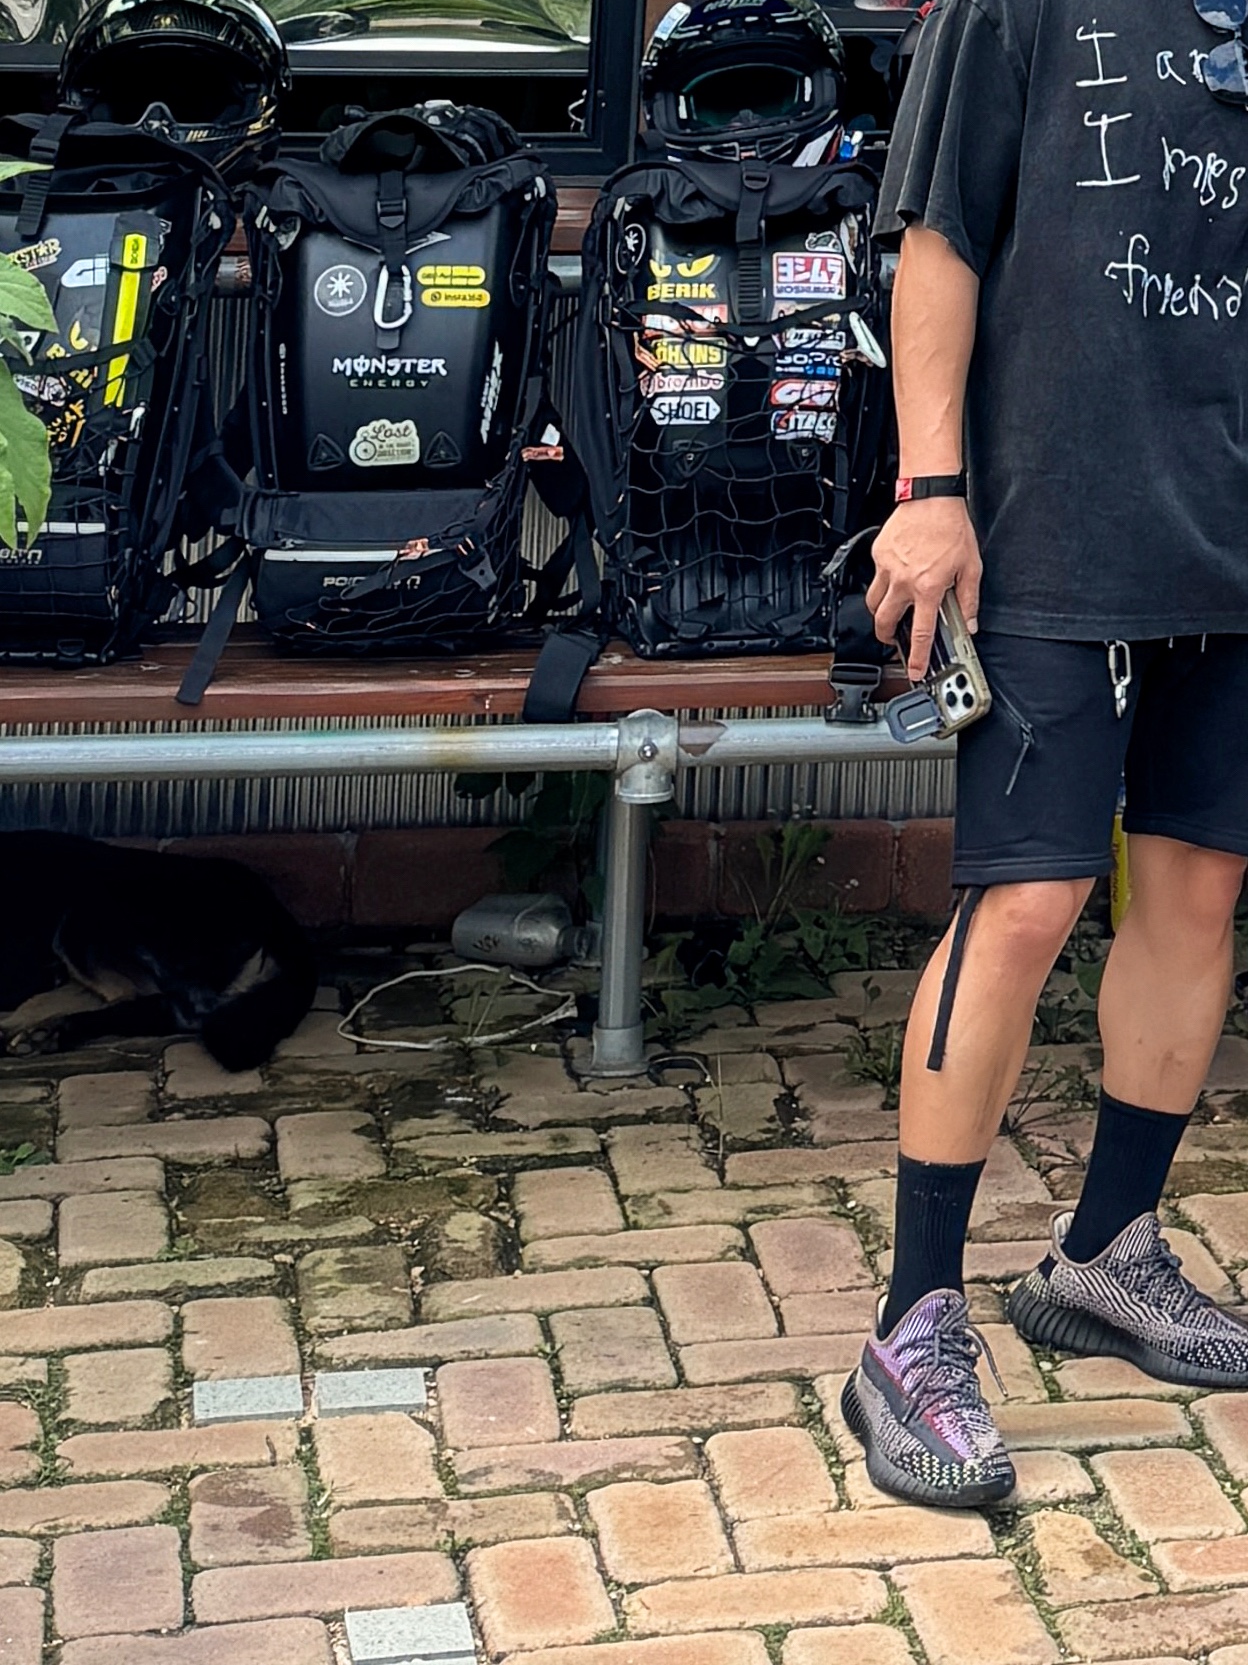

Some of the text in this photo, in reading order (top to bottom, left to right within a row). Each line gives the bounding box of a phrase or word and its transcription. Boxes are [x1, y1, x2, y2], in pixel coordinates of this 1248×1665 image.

[1075, 19, 1128, 87] I
[1075, 110, 1141, 187] I
[647, 282, 717, 302] BERIK
[332, 354, 448, 377] MONSTER
[349, 378, 429, 388] ENERGY
[656, 400, 711, 421] SHOEI
